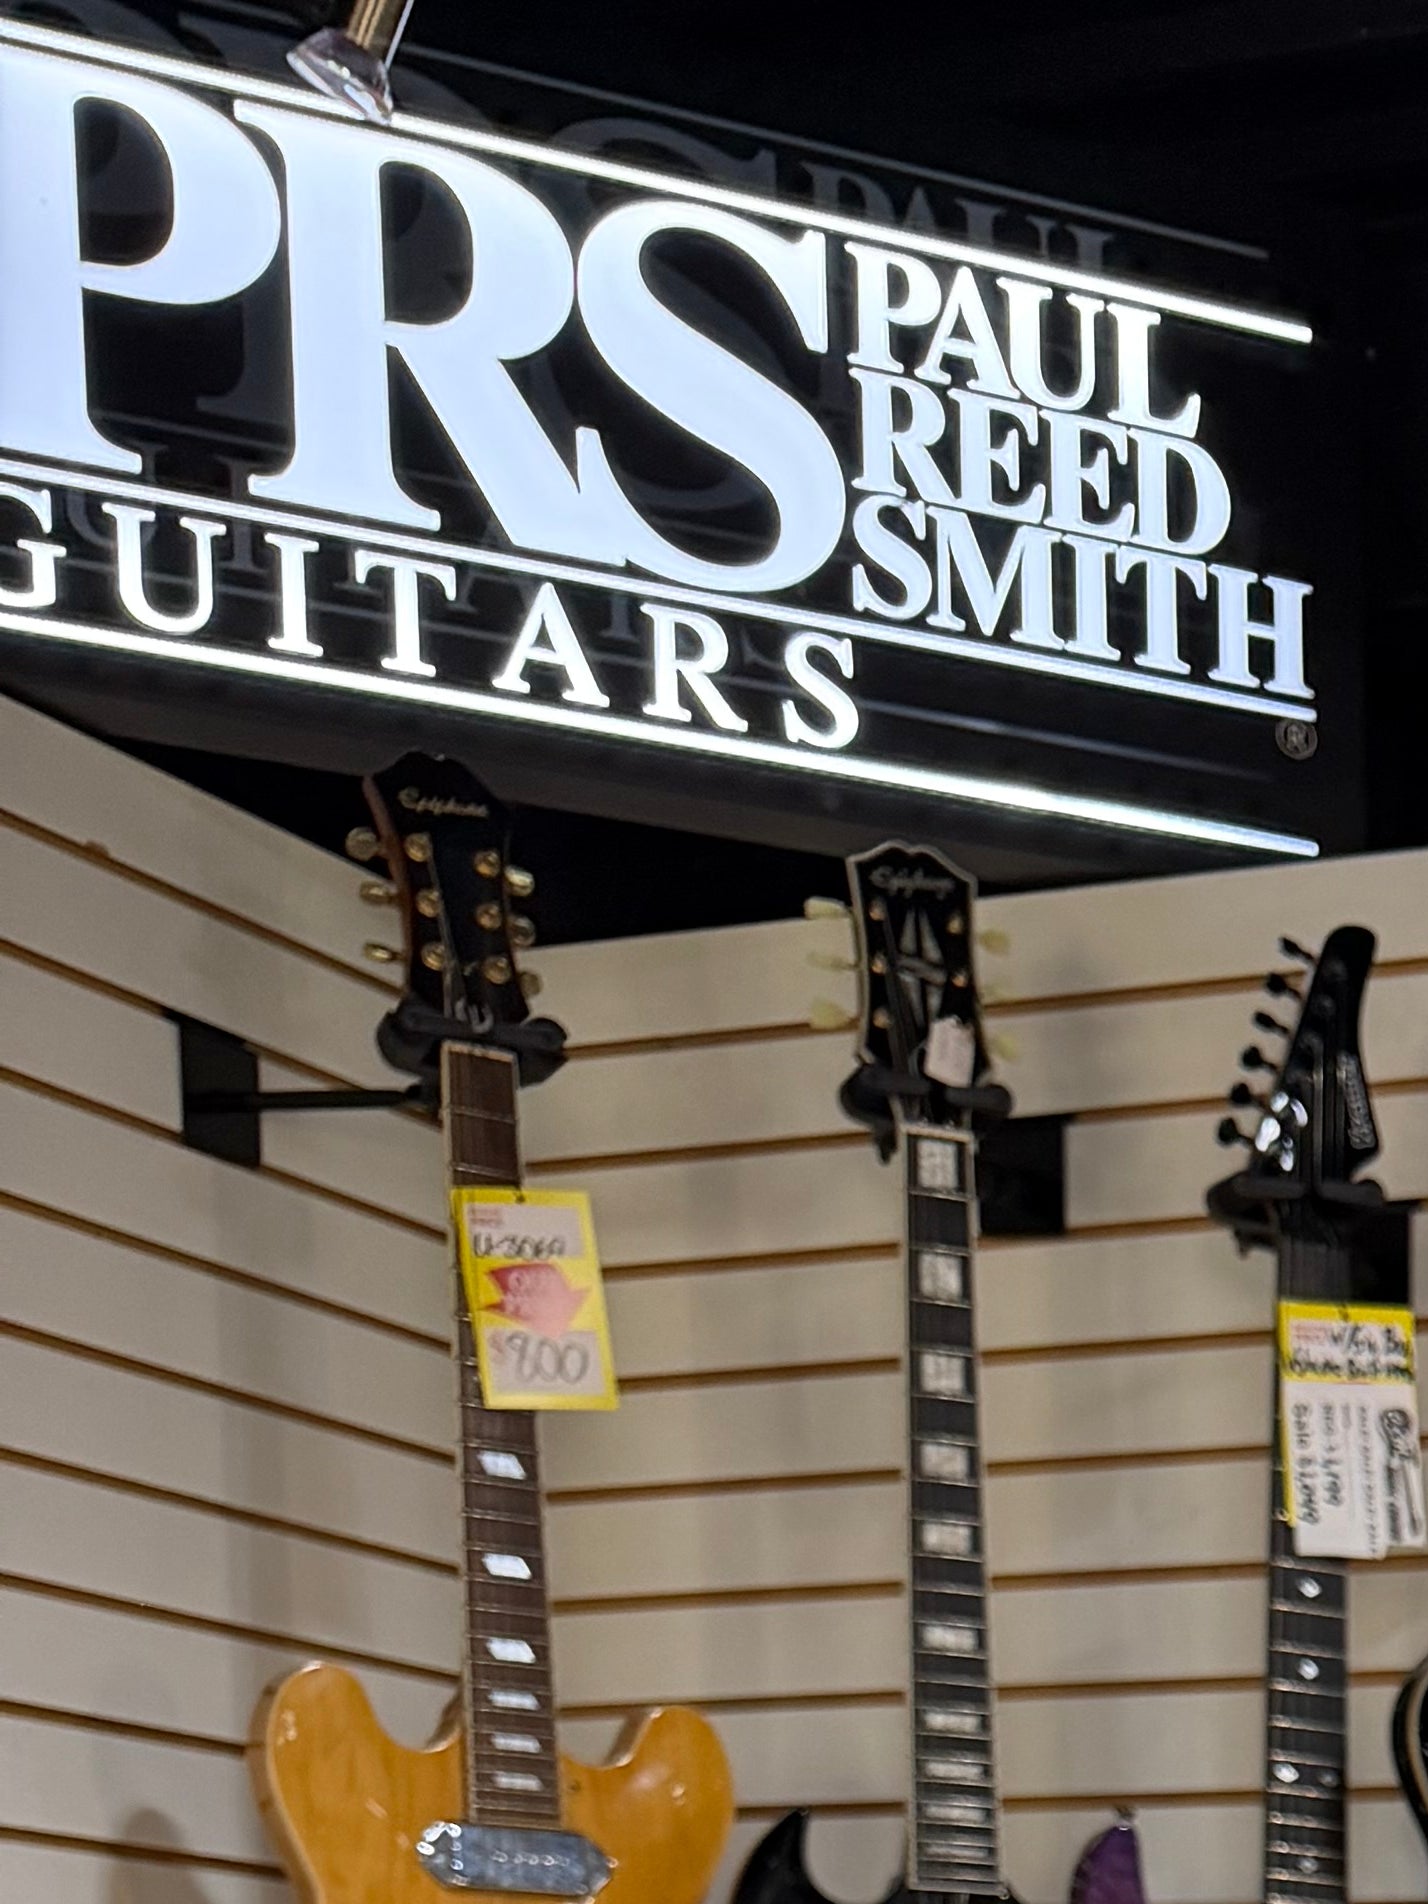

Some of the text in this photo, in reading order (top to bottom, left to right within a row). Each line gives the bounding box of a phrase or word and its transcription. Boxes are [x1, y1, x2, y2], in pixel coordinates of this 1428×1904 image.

[0, 48, 846, 595] PRS
[844, 240, 1202, 436] PAUL
[848, 368, 1233, 560] REED
[0, 481, 862, 749] GUITARS
[851, 494, 1316, 700] SMITH
